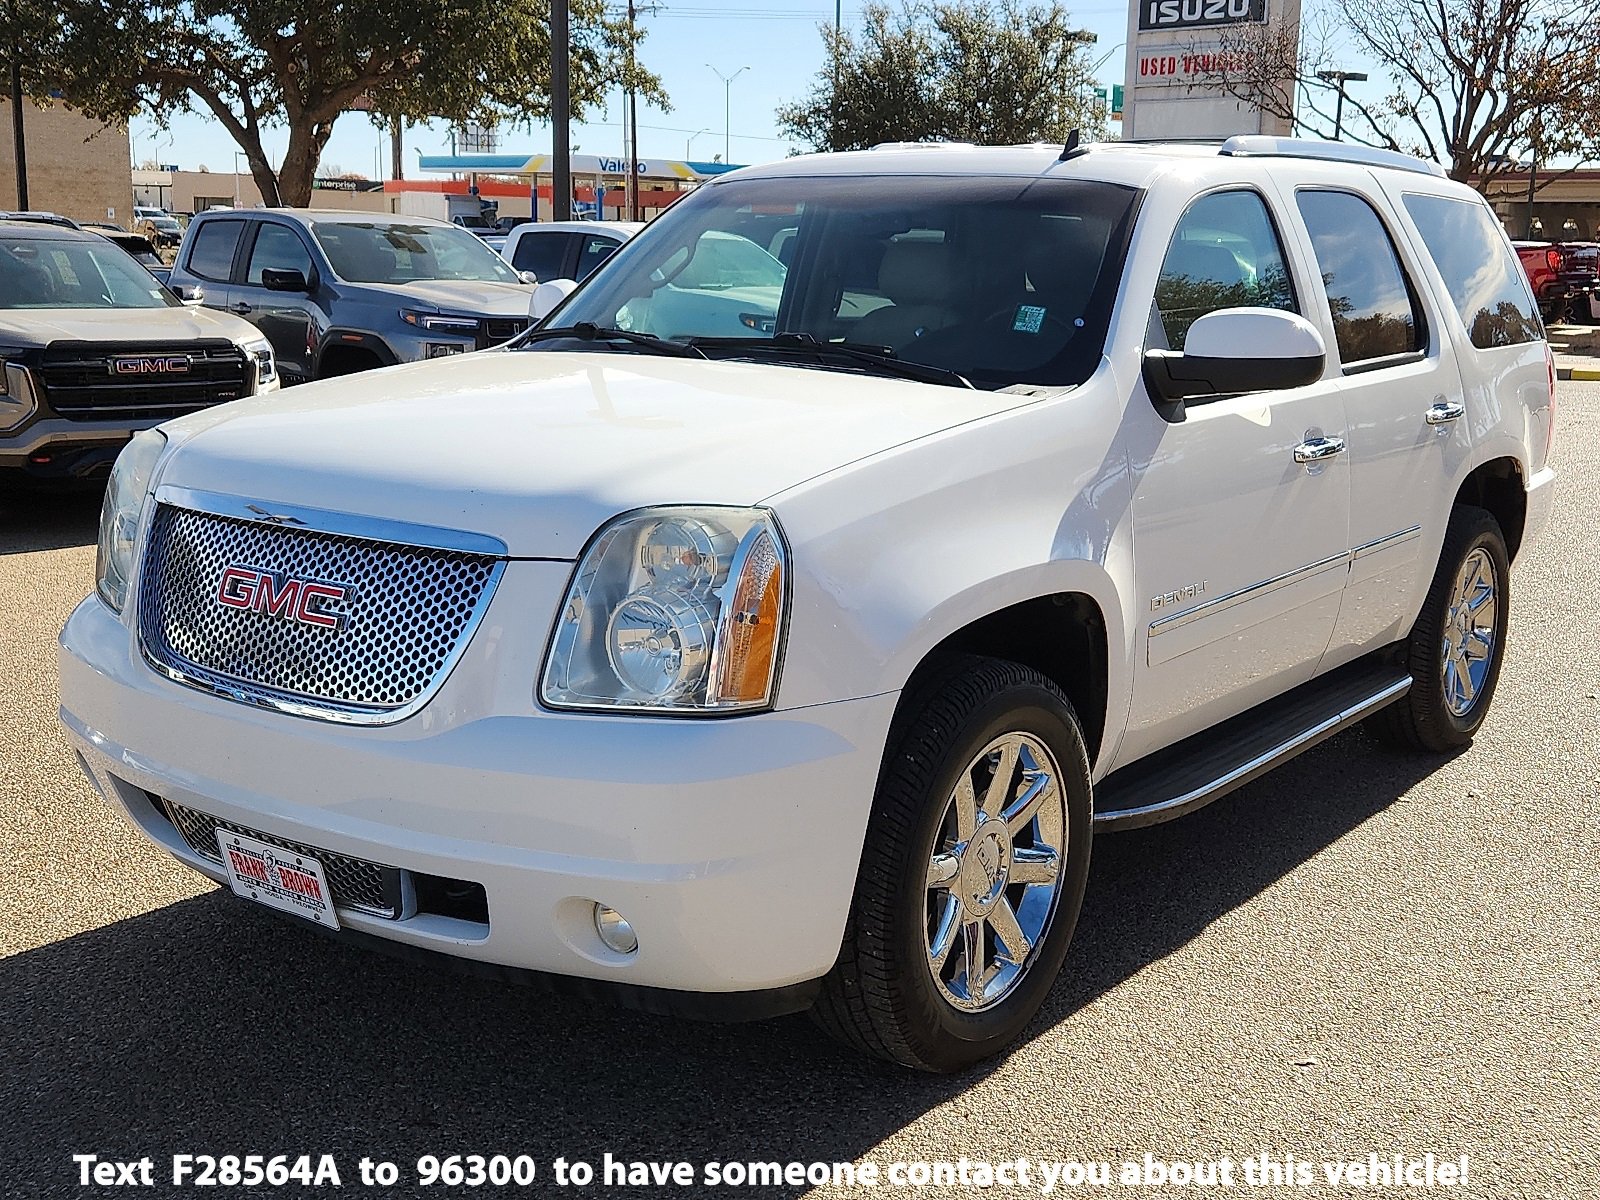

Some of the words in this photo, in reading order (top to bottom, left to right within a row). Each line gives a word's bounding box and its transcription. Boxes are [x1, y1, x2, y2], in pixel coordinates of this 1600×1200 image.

[1149, 0, 1250, 24] ISUZU
[1140, 56, 1176, 76] USED
[599, 158, 647, 174] Valeo
[116, 357, 189, 373] GMC
[217, 566, 347, 630] GMC
[1150, 579, 1208, 612] DENALI
[228, 850, 270, 883] FRANK
[277, 866, 324, 902] BROWN
